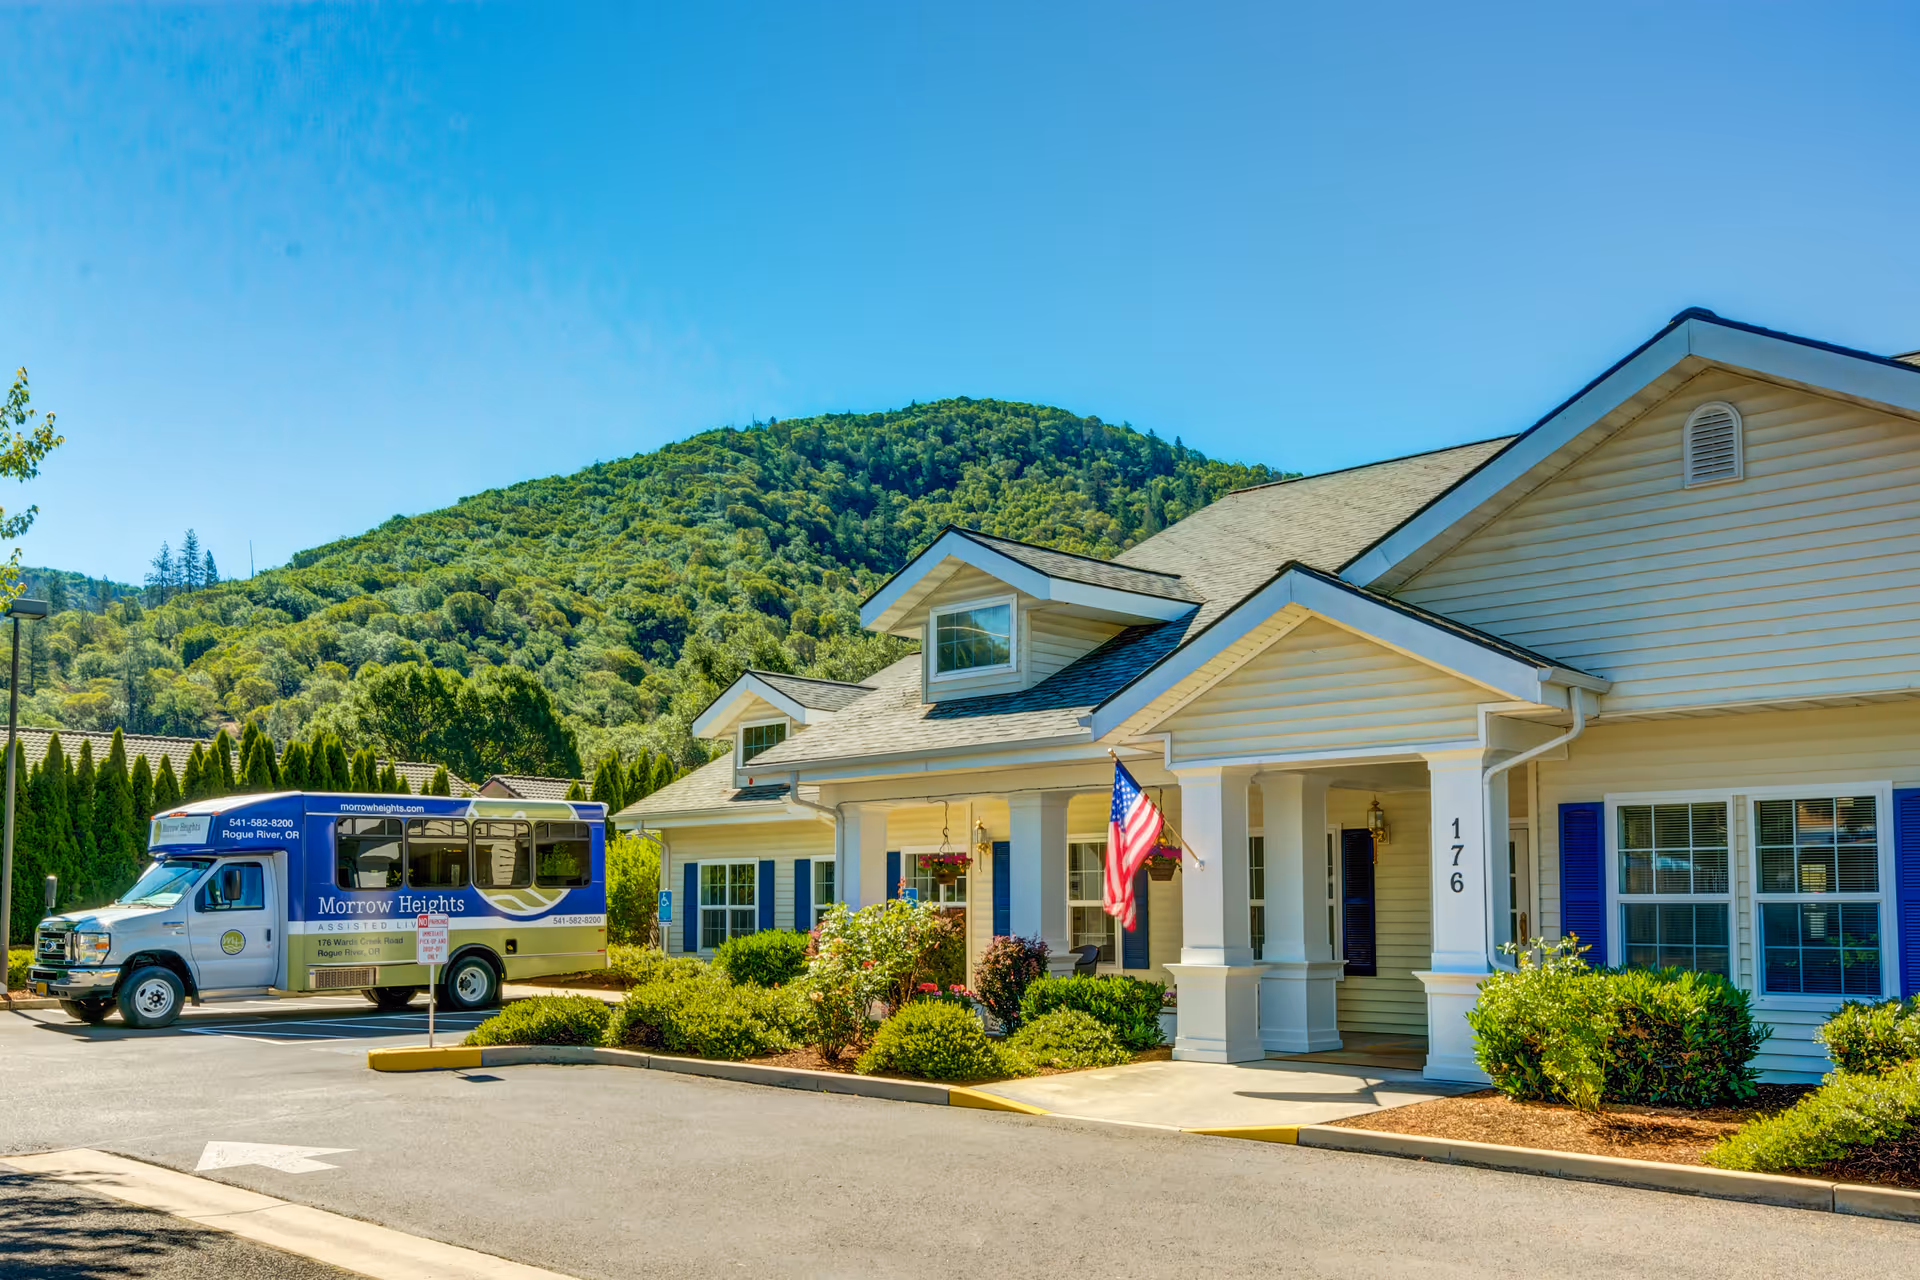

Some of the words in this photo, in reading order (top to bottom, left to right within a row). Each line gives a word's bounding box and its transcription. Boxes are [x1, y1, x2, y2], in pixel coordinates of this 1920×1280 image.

[340, 803, 425, 814] morrowheights.com
[229, 818, 294, 828] 541-582-8200
[222, 830, 254, 840] Rogue
[256, 830, 283, 840] River,
[285, 830, 300, 839] OR
[1450, 817, 1464, 893] 176
[317, 896, 393, 915] Morrow
[398, 895, 465, 914] Heights
[418, 918, 428, 927] NO
[553, 916, 602, 925] 541-582-8200
[317, 921, 387, 931] ASSISTED
[317, 938, 332, 947] 176
[333, 937, 358, 946] Wards
[359, 936, 382, 945] Creek
[383, 937, 404, 945] Road
[317, 949, 343, 959] Rogue
[344, 949, 366, 957] River,
[368, 947, 381, 956] OR
